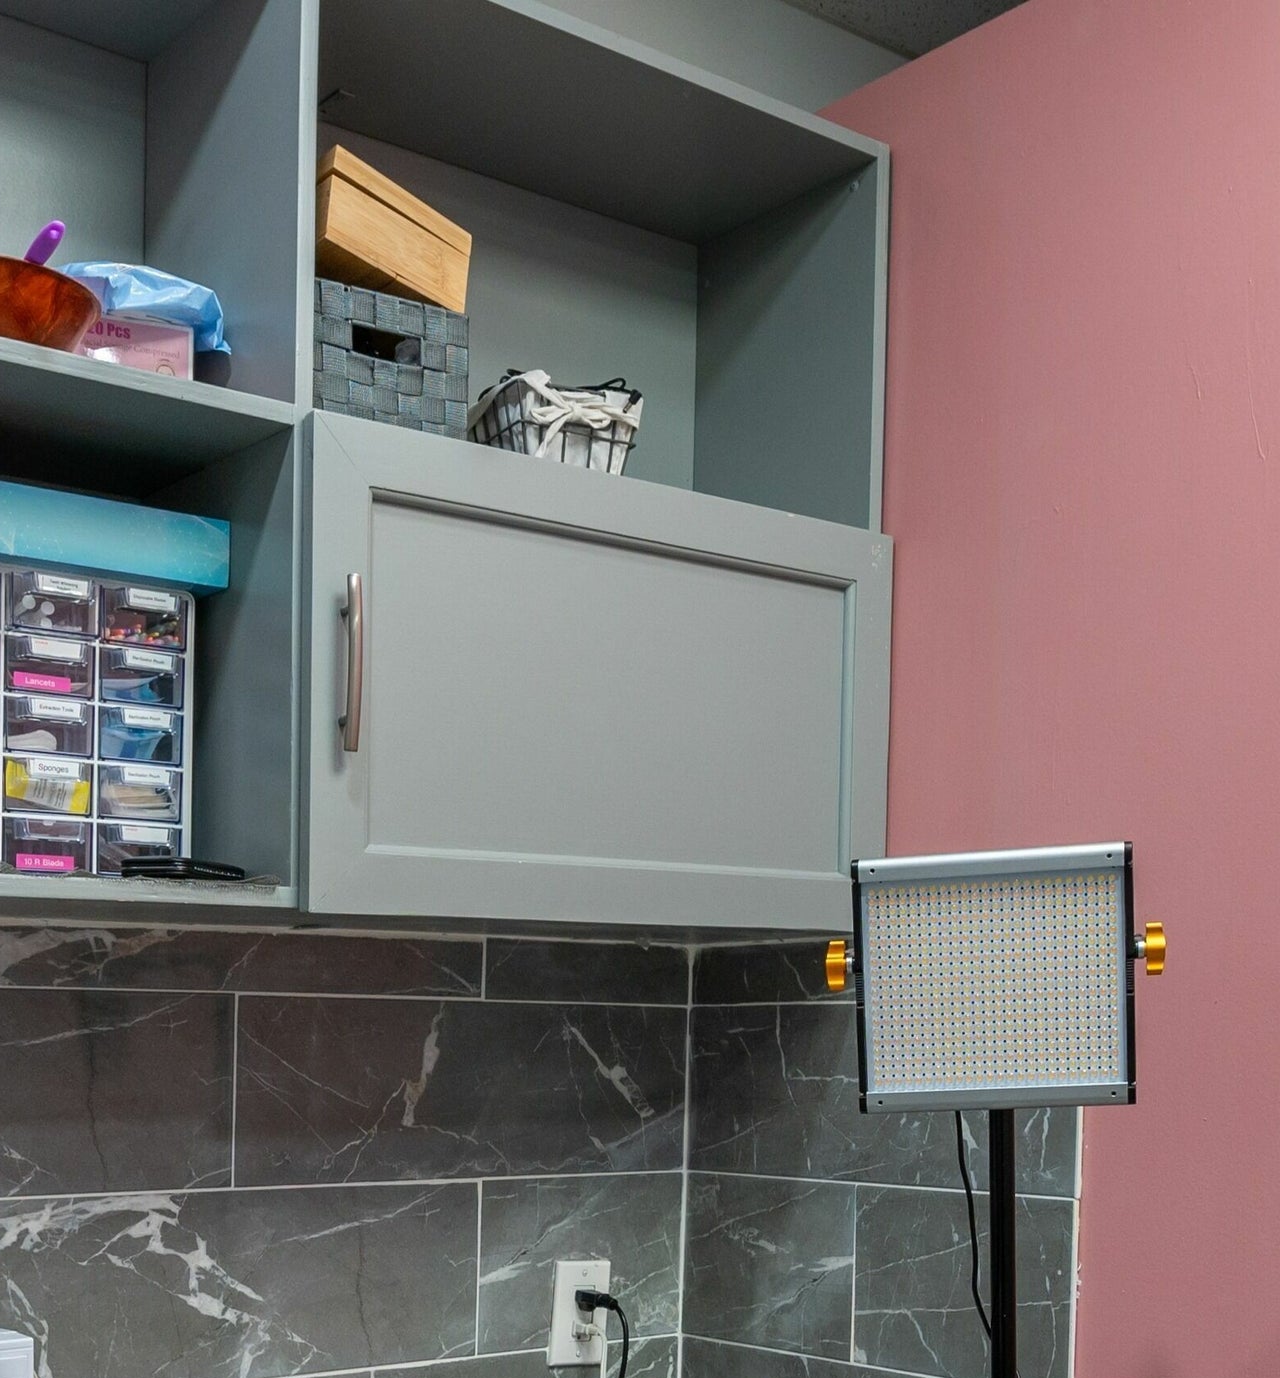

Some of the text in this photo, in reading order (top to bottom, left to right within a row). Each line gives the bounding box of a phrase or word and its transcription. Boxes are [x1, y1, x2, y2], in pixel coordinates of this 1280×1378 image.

[24, 676, 56, 688] Lancets
[38, 763, 69, 775] Sponges
[23, 858, 65, 868] 10 R Blade
